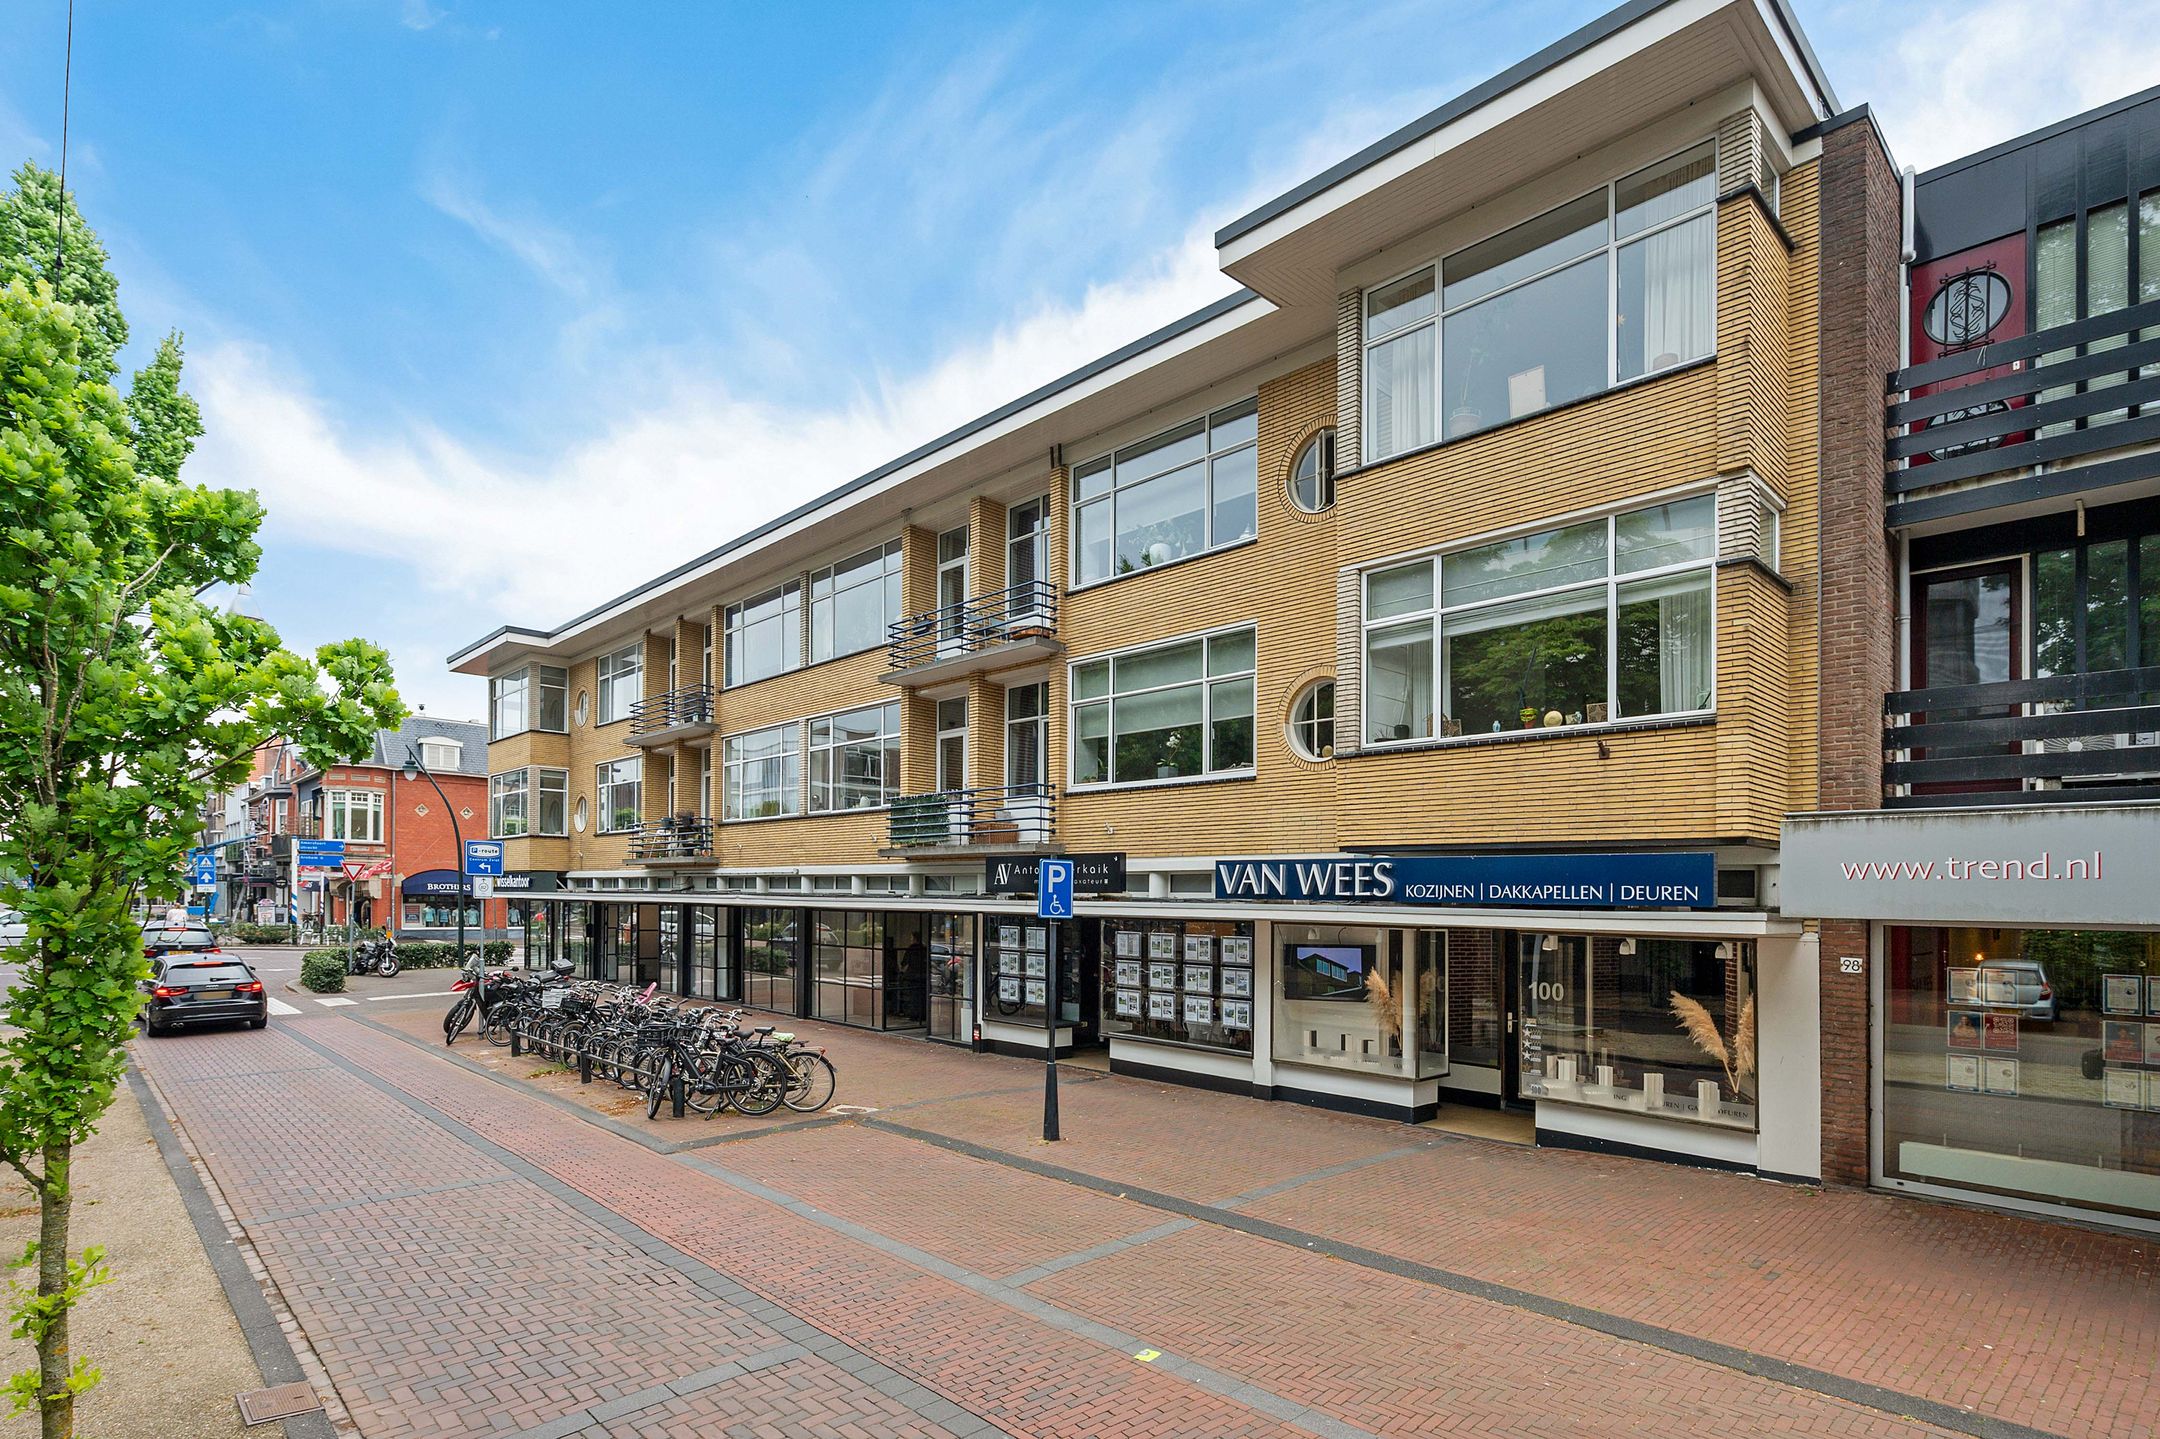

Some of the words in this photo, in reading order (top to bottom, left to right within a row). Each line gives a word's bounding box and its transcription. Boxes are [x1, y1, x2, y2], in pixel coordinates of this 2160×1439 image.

[1014, 865, 1040, 875] Anto
[1840, 851, 2102, 881] www.trend.nl
[1048, 864, 1066, 893] P
[1218, 863, 1286, 896] VAN
[1295, 862, 1397, 897] WEES
[1405, 884, 1475, 900] KOZIJNEN
[1489, 884, 1603, 900] DAKKAPELLEN
[1620, 885, 1699, 901] DEUREN
[1841, 959, 1860, 972] 98
[1528, 981, 1564, 1002] 100
